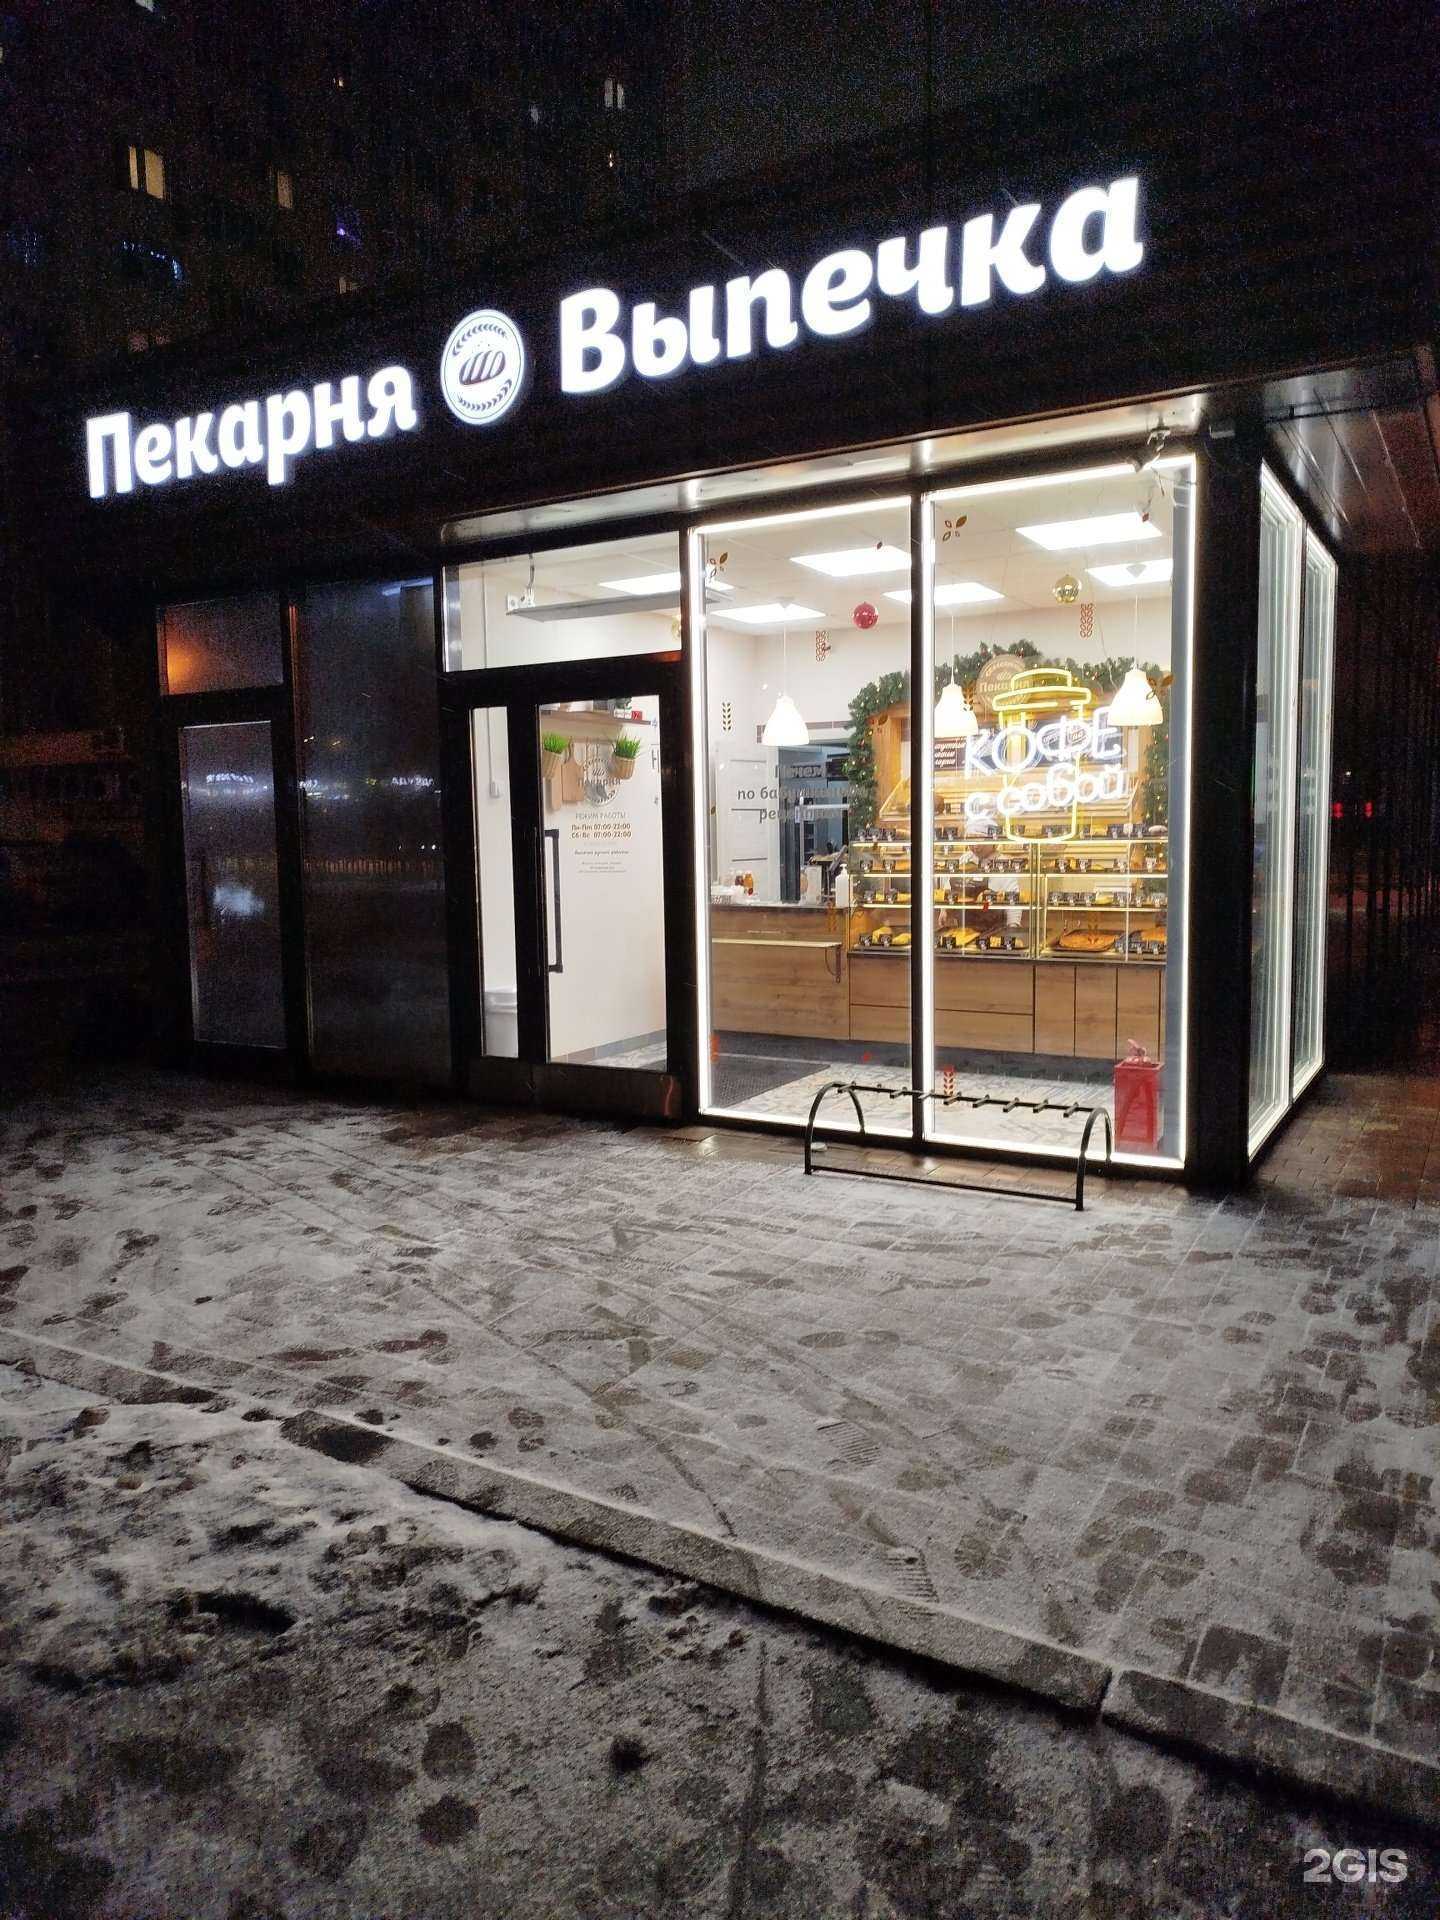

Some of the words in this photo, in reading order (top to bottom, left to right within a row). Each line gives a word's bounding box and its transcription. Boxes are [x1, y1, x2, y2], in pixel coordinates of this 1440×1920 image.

[86, 366, 416, 498] Пекарня
[560, 177, 1143, 393] Выпечка
[737, 789, 755, 800] по
[998, 762, 1128, 817] собой
